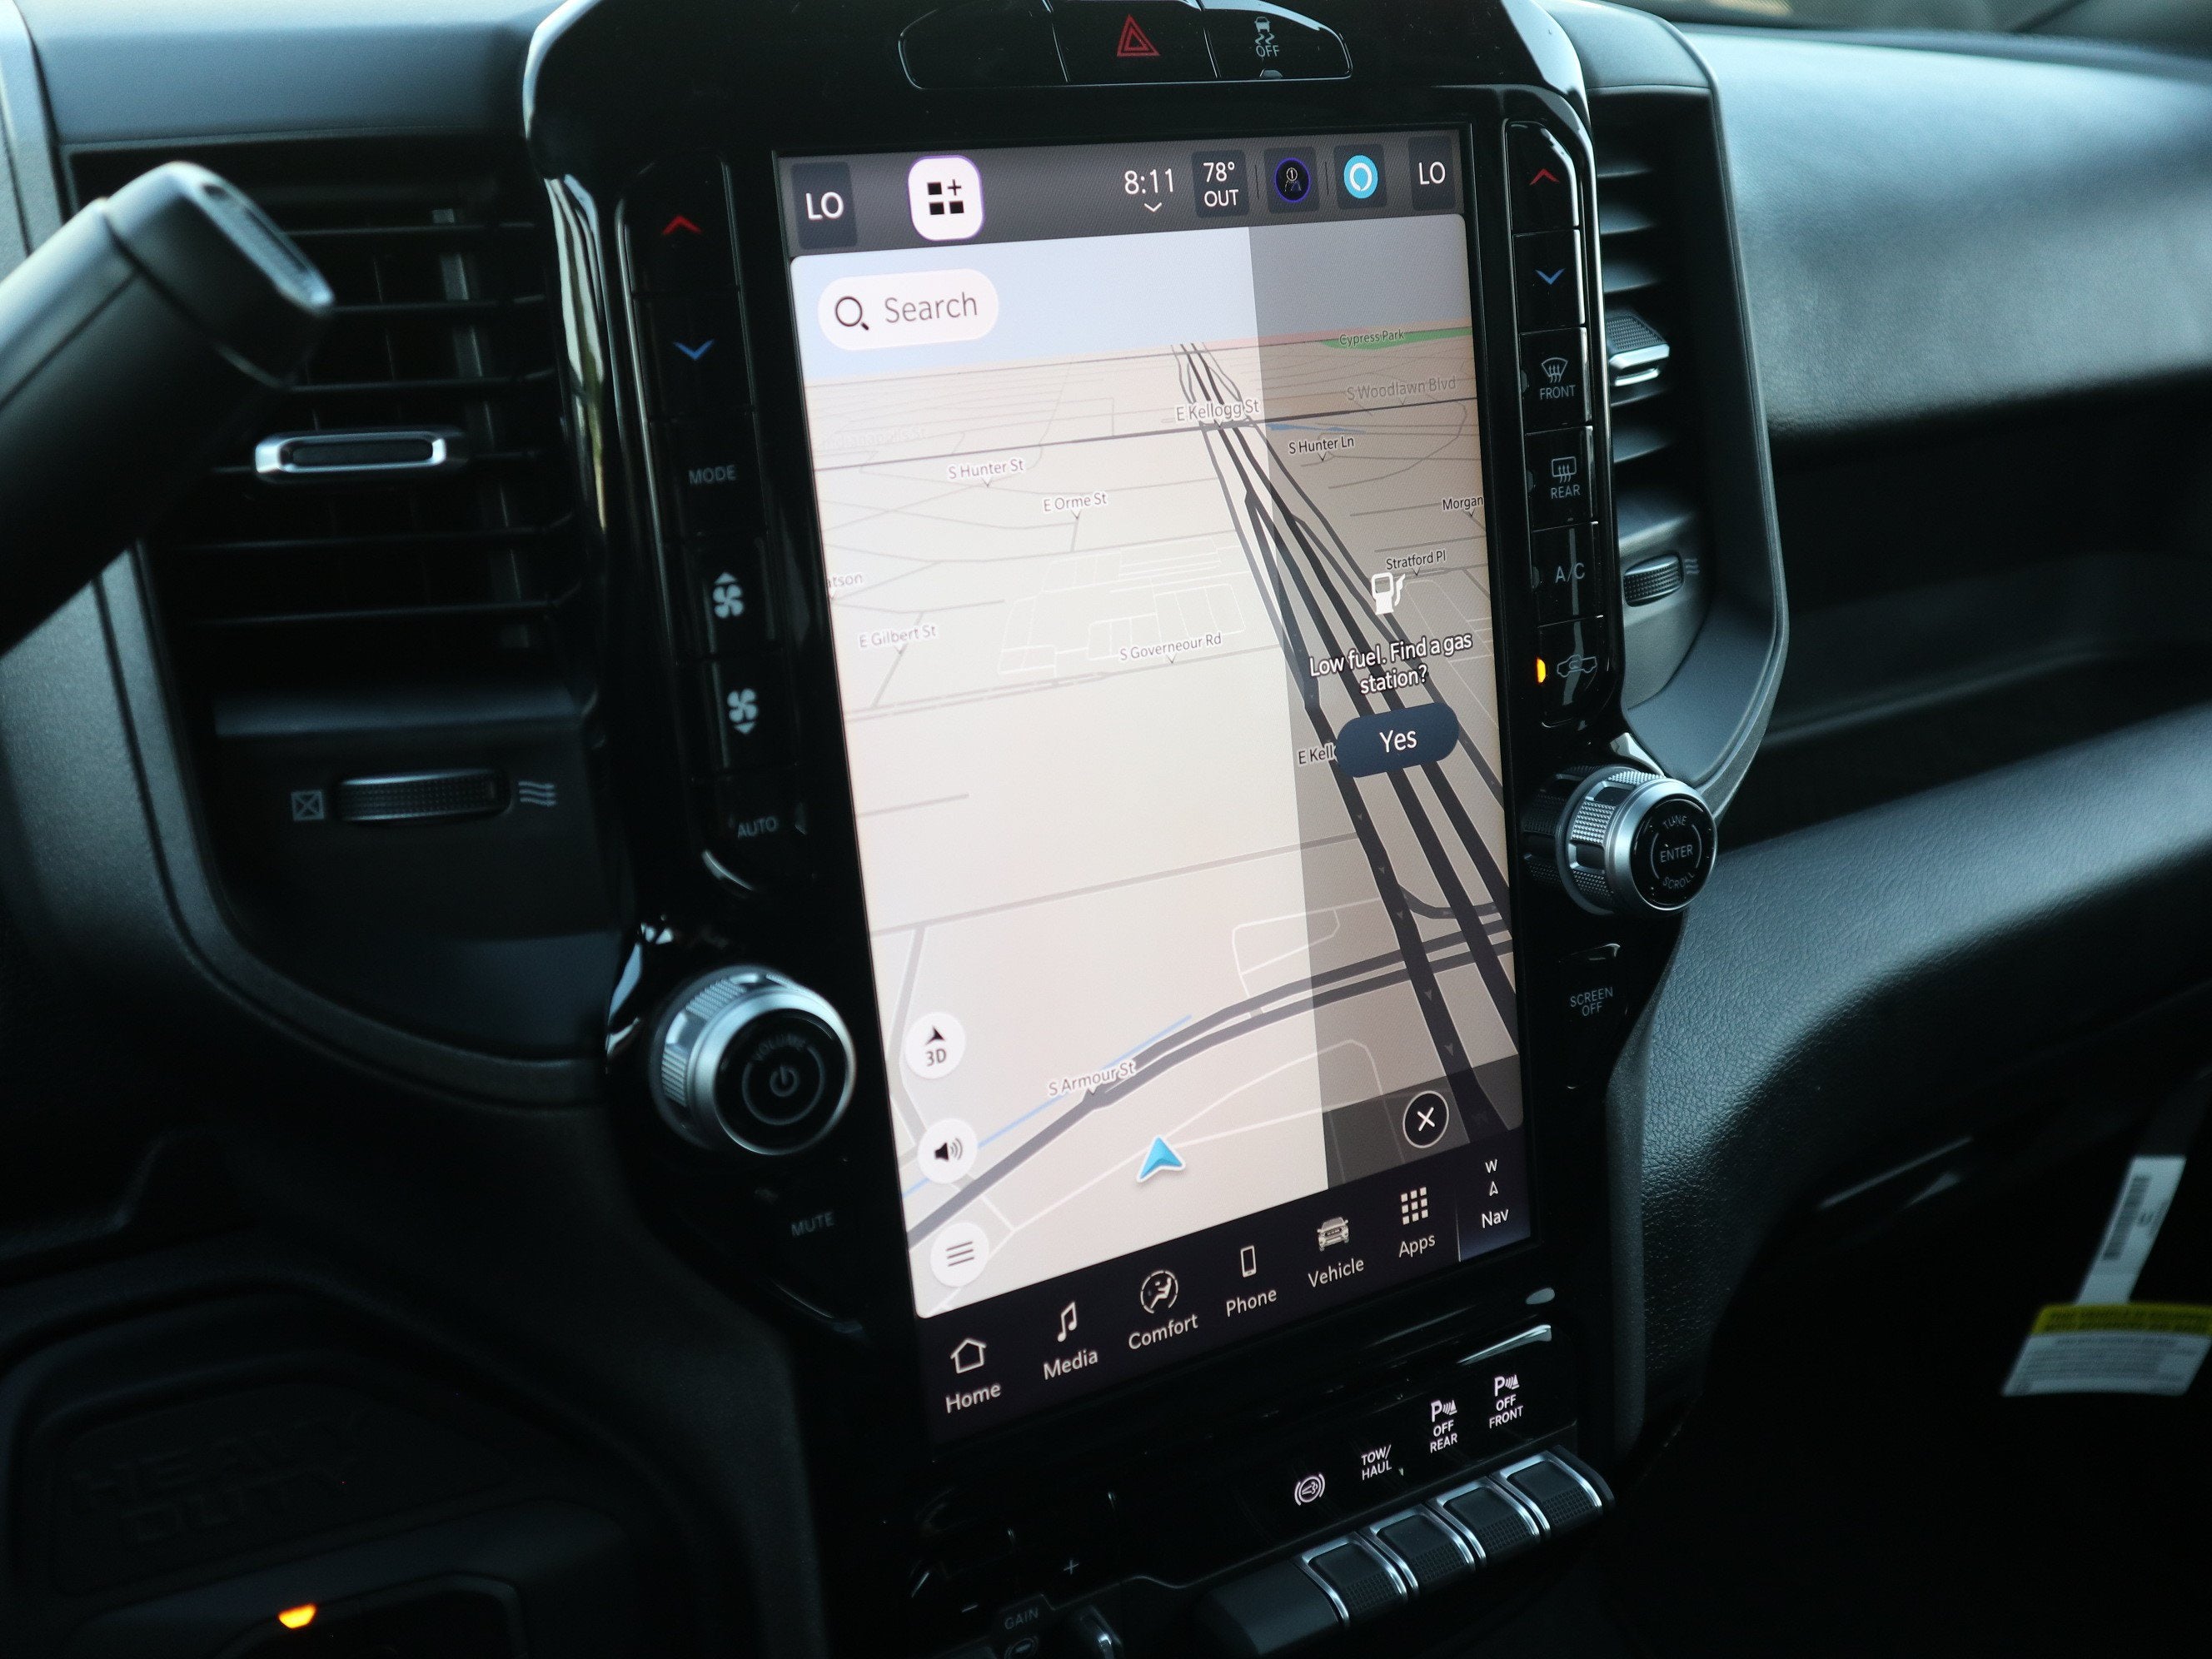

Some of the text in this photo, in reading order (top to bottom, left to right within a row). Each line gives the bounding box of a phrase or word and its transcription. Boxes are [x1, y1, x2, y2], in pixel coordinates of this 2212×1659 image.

[1255, 45, 1280, 58] OFF
[1123, 168, 1173, 196] 8:11
[1203, 161, 1235, 182] 78°
[1418, 161, 1446, 186] LO
[805, 192, 844, 222] LO
[1204, 189, 1239, 208] OUT
[884, 292, 978, 324] Search
[1338, 328, 1405, 347] Cypress Park
[1348, 376, 1457, 401] S Woodlawn Blvd
[1539, 385, 1576, 400] FRONT
[1176, 400, 1260, 421] E Kellogg St
[1288, 436, 1354, 454] S Hunter Ln
[688, 465, 738, 486] MODE
[948, 458, 1024, 480] S Hunter St
[1044, 492, 1107, 512] E Orme St
[1551, 485, 1581, 500] REAR
[1442, 496, 1483, 511] Morgan
[1386, 550, 1447, 570] Stratford Pl
[1555, 562, 1586, 583] A/C
[859, 625, 936, 648] E Gilbert St
[1119, 633, 1222, 661] S Governeour Rd
[1309, 633, 1472, 677] Low fuel. Find a gas
[1359, 664, 1428, 695] station?
[1379, 730, 1417, 754] Yes
[1298, 745, 1336, 765] E Kell
[737, 815, 780, 839] AUTO
[1662, 815, 1688, 830] TUNE
[1660, 844, 1693, 863] ENTER
[1662, 871, 1696, 891] SCROLL
[1570, 985, 1613, 1008] SCREEN
[1582, 1001, 1603, 1017] OFF
[925, 1048, 947, 1068] 3D
[1048, 1061, 1136, 1097] S Armour St
[1484, 1158, 1498, 1174] W
[790, 1211, 834, 1237] MUTE
[1481, 1208, 1509, 1229] Nav
[1398, 1233, 1436, 1258] Apps
[1308, 1257, 1365, 1288] Vehicle
[1225, 1288, 1278, 1318] Phone
[1128, 1313, 1199, 1351] Comfort
[1043, 1348, 1099, 1381] Media
[945, 1383, 1002, 1414] Home
[1496, 1393, 1517, 1412] OFF
[1488, 1405, 1524, 1429] FRONT
[1432, 1419, 1455, 1437] OFF
[1429, 1432, 1457, 1453] REAR
[1361, 1444, 1392, 1466] TOW/
[1362, 1460, 1392, 1481] HAUL
[1004, 1607, 1039, 1630] GAIN
